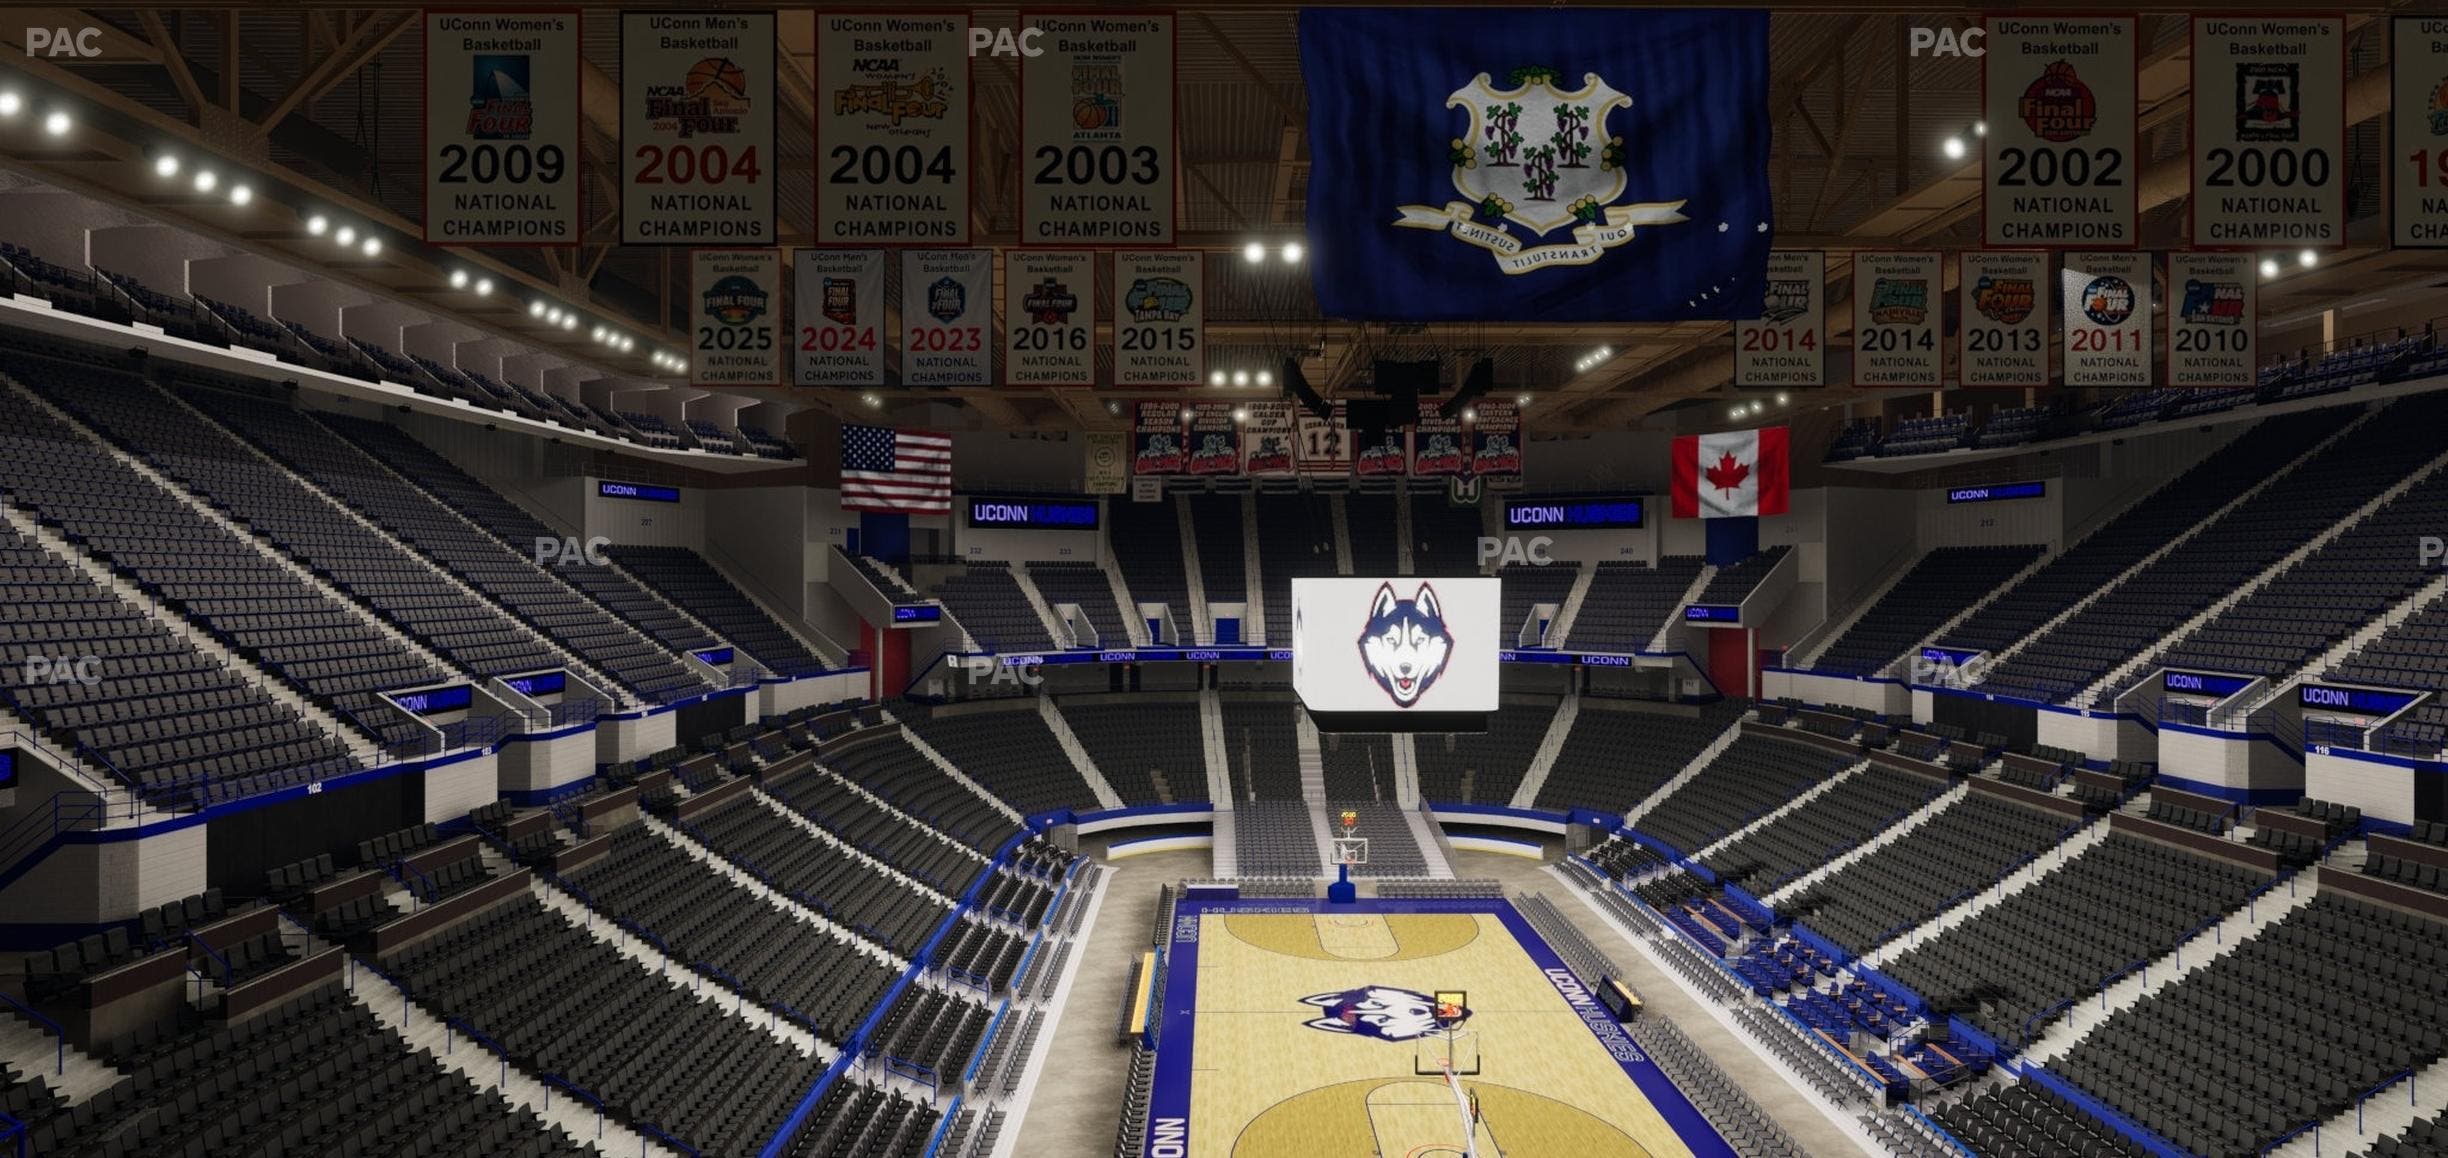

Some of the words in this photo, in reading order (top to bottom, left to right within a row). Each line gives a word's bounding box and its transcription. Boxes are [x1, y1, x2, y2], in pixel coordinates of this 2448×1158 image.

[440, 18, 491, 31] UConn
[495, 18, 564, 31] Women's
[650, 17, 701, 30] UConn
[706, 17, 749, 30] Men's
[831, 19, 882, 32] UConn
[886, 19, 955, 32] Women's
[1035, 19, 1086, 33] UConn
[1090, 19, 1160, 33] Women's
[1999, 21, 2049, 35] UConn
[2053, 21, 2121, 35] Women's
[2207, 22, 2258, 36] UConn
[2261, 22, 2329, 36] Women's
[463, 37, 541, 51] Basketball
[660, 36, 738, 50] Basketball
[854, 38, 932, 52] Basketball
[1059, 39, 1137, 52] Basketball
[2021, 41, 2099, 55] Basketball
[2229, 41, 2307, 55] Basketball
[852, 59, 899, 71] NCAA
[439, 144, 565, 184] 2009
[634, 145, 761, 184] 2004
[829, 145, 956, 184] 2004
[1034, 145, 1160, 185] 2003
[1997, 147, 2123, 187] 2002
[2205, 147, 2330, 187] 2000
[455, 194, 556, 211] NATIONAL
[651, 195, 752, 211] NATIONAL
[845, 195, 947, 211] NATIONAL
[1050, 195, 1151, 211] NATIONAL
[2013, 197, 2114, 213] NATIONAL
[2221, 197, 2322, 213] NATIONAL
[443, 220, 566, 236] CHAMPIONS
[639, 220, 762, 236] CHAMPIONS
[834, 221, 957, 237] CHAMPIONS
[1039, 221, 1161, 237] CHAMPIONS
[2002, 222, 2123, 239] CHAMPIONS
[2210, 222, 2331, 239] CHAMPIONS
[1768, 265, 1803, 273] sketball
[699, 327, 773, 350] 2025
[802, 326, 876, 351] 2024
[910, 327, 982, 351] 2023
[1013, 327, 1087, 350] 2016
[1121, 327, 1195, 350] 2015
[1743, 328, 1816, 351] 2014
[1861, 328, 1934, 351] 2014
[1968, 328, 2041, 351] 2013
[2071, 328, 2142, 351] 2011
[2175, 328, 2248, 351] 2010
[708, 356, 767, 366] NATIONAL
[810, 356, 869, 366] NATIONAL
[916, 357, 977, 367] NATIONAL
[1022, 356, 1081, 366] NATIONAL
[1130, 356, 1189, 366] NATIONAL
[1752, 357, 1811, 367] NATIONAL
[1870, 357, 1929, 367] NATIONAL
[1977, 357, 2035, 367] NATIONAL
[2080, 357, 2139, 367] NATIONAL
[2184, 357, 2242, 367] NATIONAL
[701, 371, 773, 381] CHAMPIONS
[804, 370, 874, 381] CHAMPIONS
[912, 372, 982, 382] CHAMPIONS
[1015, 371, 1087, 381] CHAMPIONS
[1124, 371, 1195, 381] CHAMPIONS
[1745, 372, 1816, 382] CHAMPIONS
[1863, 372, 1935, 382] CHAMPIONS
[1970, 372, 2042, 382] CHAMPIONS
[2073, 372, 2145, 382] CHAMPIONS
[2177, 372, 2248, 382] CHAMPIONS
[1309, 432, 1340, 455] 12
[602, 483, 637, 497] UCONN
[1951, 488, 1989, 501] UCONN
[974, 504, 1028, 521] UCONN
[1510, 507, 1565, 524] UCONN
[1100, 652, 1135, 662] UCONN
[1186, 651, 1219, 660] UCONN
[1582, 655, 1630, 666] UCONN
[2166, 672, 2202, 690] UCONN
[2303, 687, 2349, 707] UCONN
[307, 782, 322, 795] 102
[1545, 968, 1597, 1010] UCONN
[1580, 1006, 1645, 1062] HUSKIES
[1151, 1118, 1185, 1158] ONN
